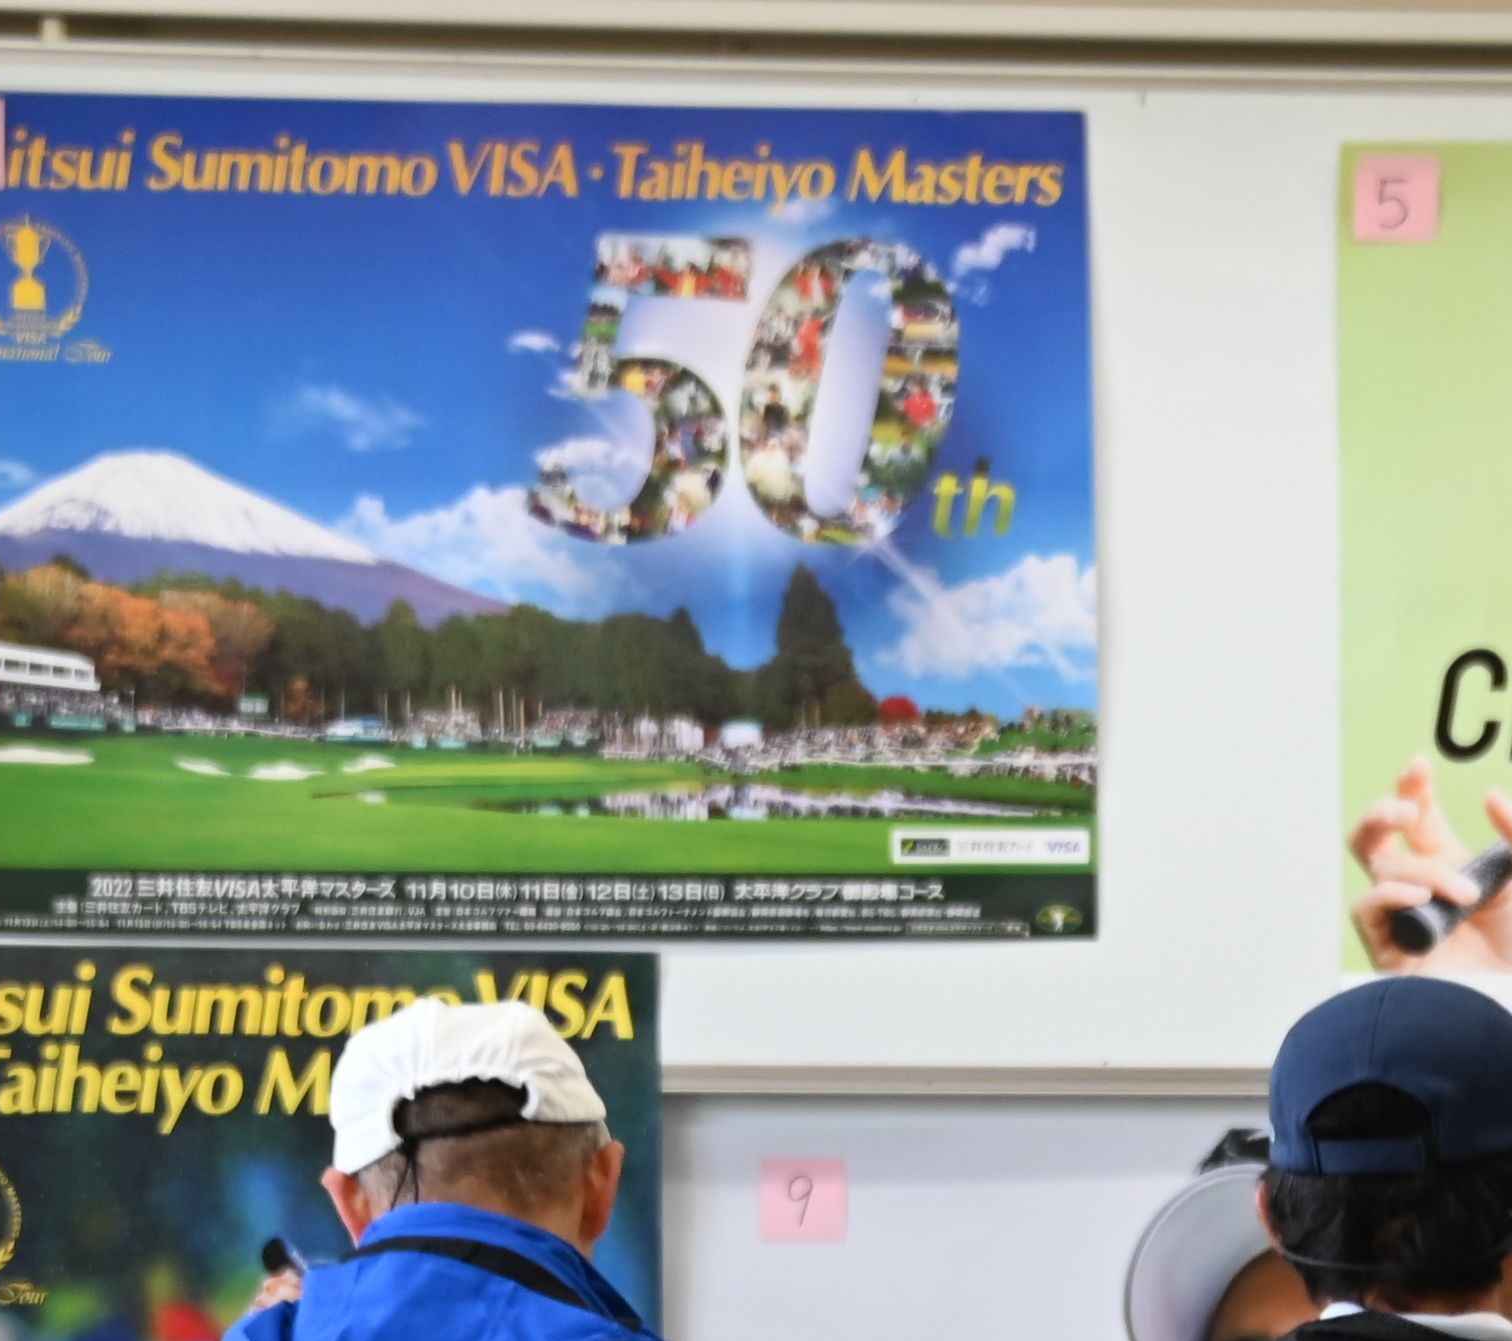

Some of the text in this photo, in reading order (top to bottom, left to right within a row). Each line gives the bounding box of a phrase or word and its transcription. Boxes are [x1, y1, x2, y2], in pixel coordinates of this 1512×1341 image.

[7, 128, 1064, 216] itsui Sumitomo VISA Taiheiyo Masters
[1374, 176, 1411, 230] 5
[92, 877, 133, 899] 2022
[105, 963, 463, 1037] Sumitom
[785, 1173, 814, 1228] 9
